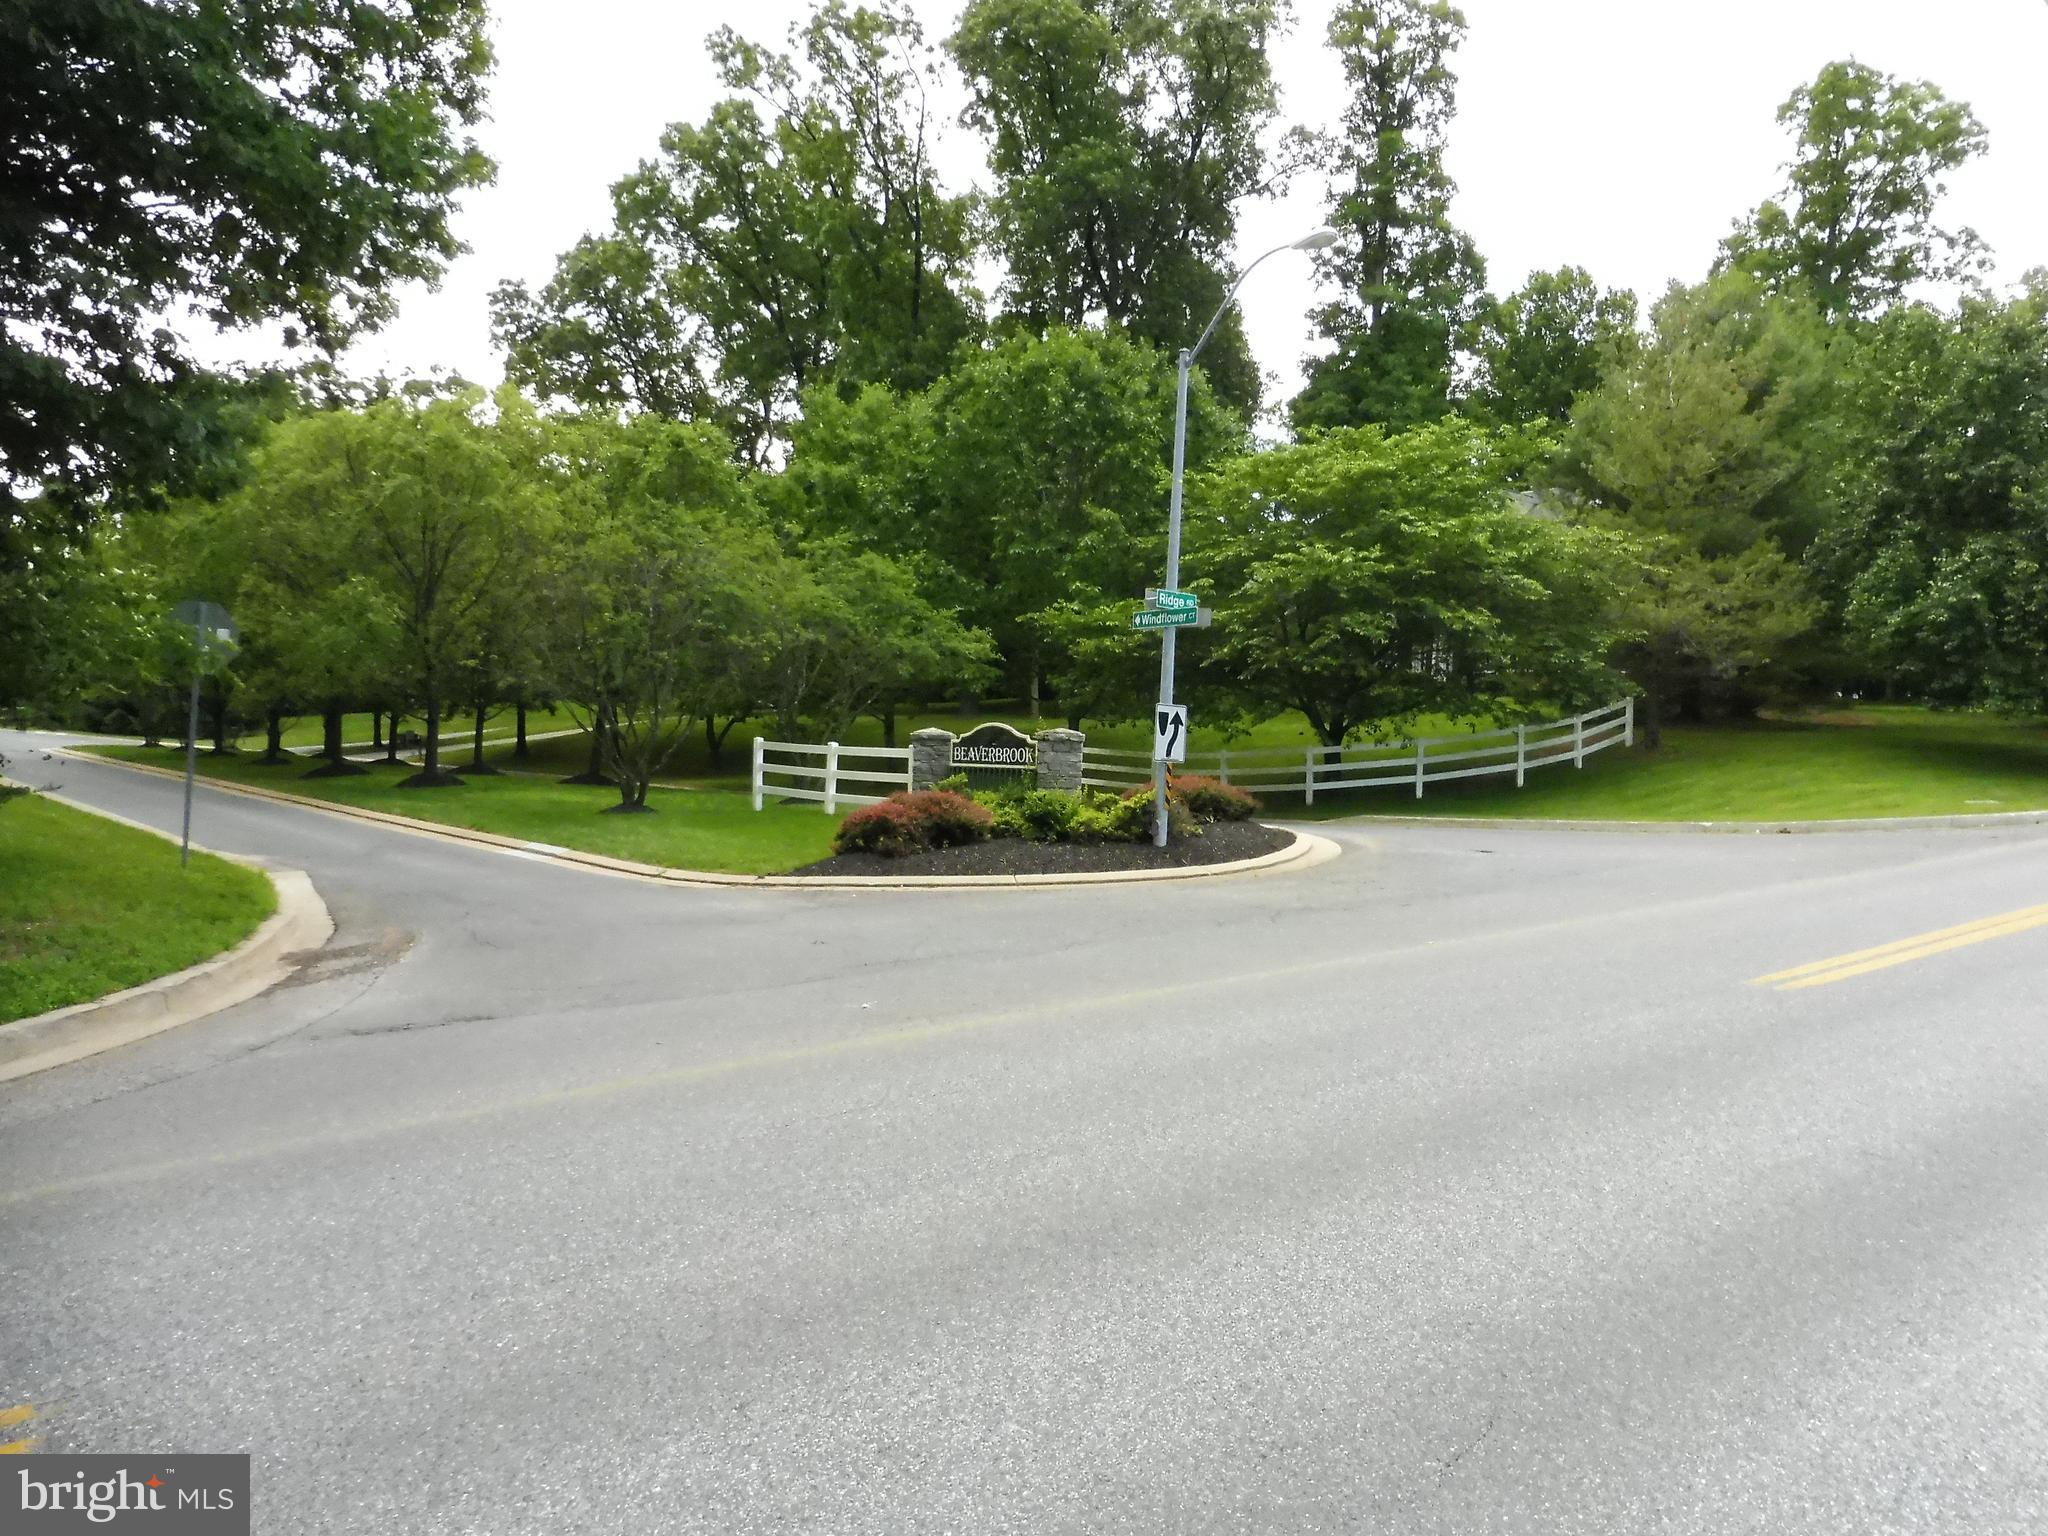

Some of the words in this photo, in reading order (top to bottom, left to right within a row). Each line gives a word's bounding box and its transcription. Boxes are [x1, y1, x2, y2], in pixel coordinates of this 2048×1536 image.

[1159, 592, 1185, 608] Ridge
[1141, 612, 1187, 625] Windflower
[953, 745, 1034, 763] BEAVERBROOK
